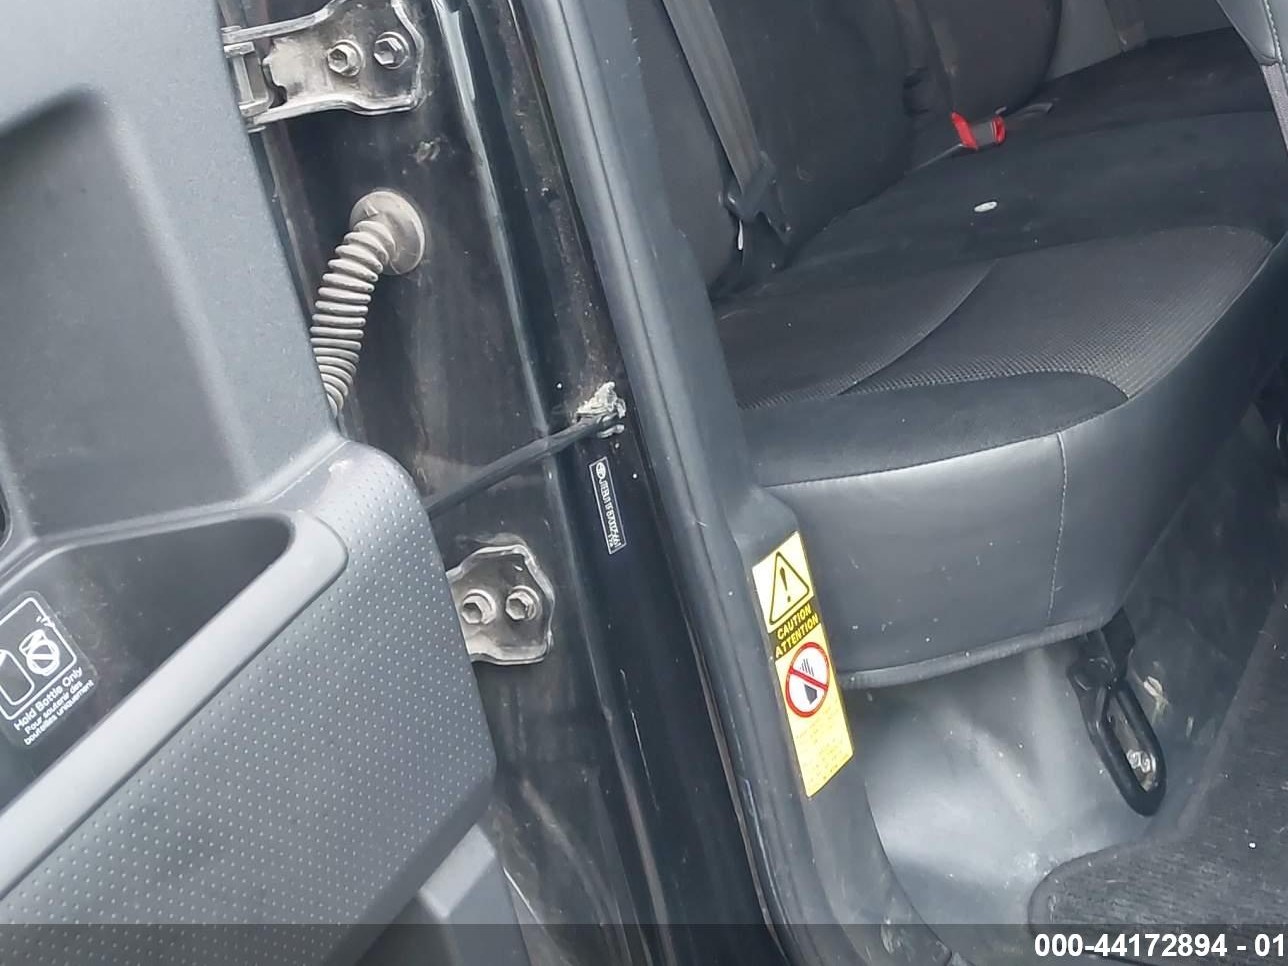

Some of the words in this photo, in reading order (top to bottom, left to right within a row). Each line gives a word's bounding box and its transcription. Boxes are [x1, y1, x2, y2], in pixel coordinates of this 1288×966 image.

[775, 612, 819, 659] ATTENTION
[777, 602, 812, 640] CAUTION
[13, 707, 37, 731] Hold
[35, 685, 63, 712] Bottle
[62, 666, 83, 687] Only
[23, 714, 58, 745] bouteilles
[56, 679, 95, 716] uniquement
[24, 716, 43, 735] Pour
[43, 691, 70, 719] soutenir
[69, 680, 83, 694] des
